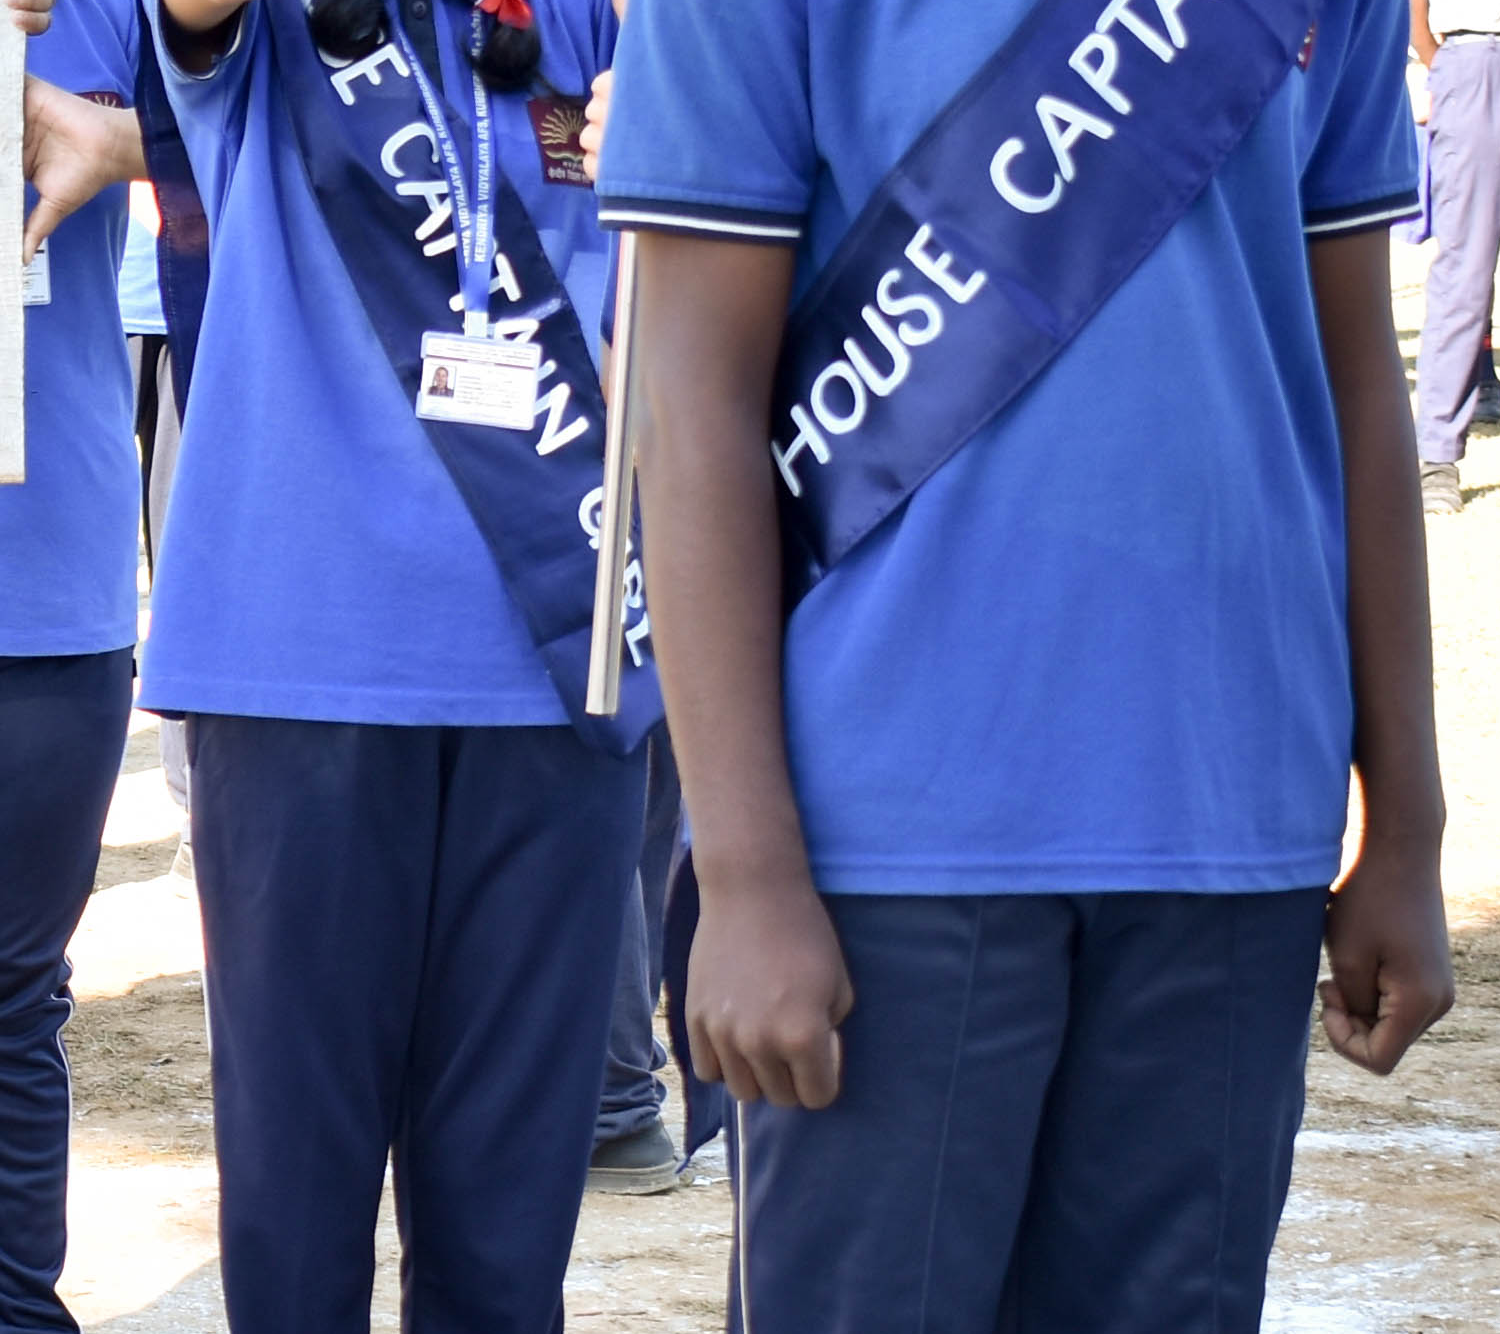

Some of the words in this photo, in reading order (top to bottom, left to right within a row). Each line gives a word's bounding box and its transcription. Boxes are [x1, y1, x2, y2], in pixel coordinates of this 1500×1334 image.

[449, 166, 471, 228] VIDYALAYA
[477, 142, 490, 201] VIDYALAYA
[474, 203, 489, 262] KENDRIYA
[770, 223, 986, 498] HOUSE
